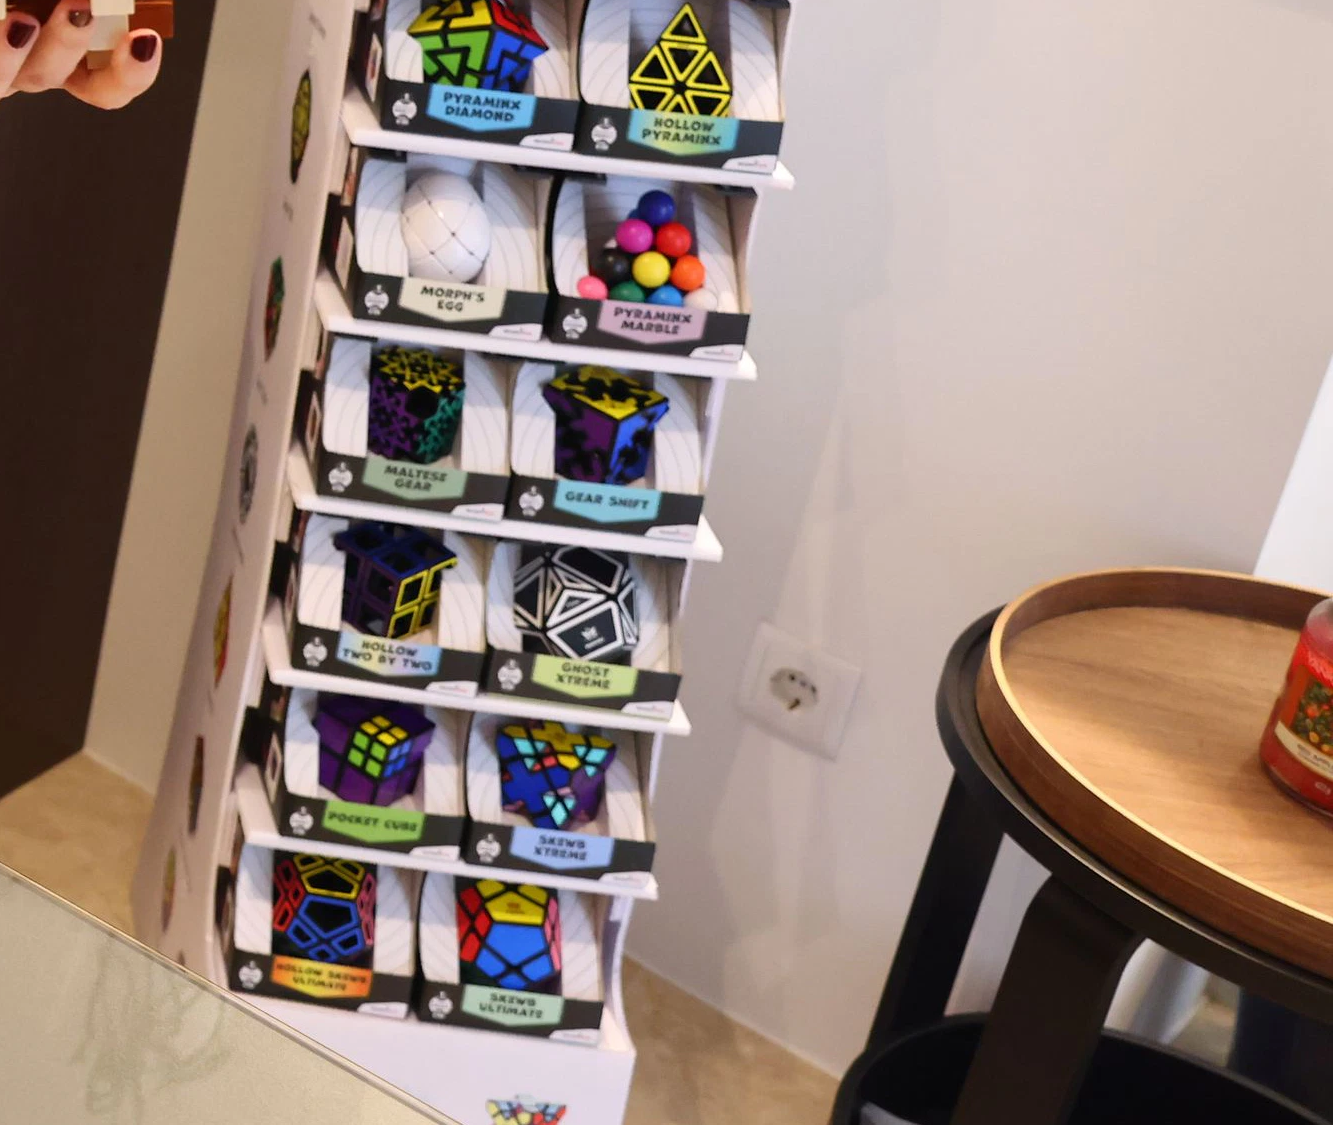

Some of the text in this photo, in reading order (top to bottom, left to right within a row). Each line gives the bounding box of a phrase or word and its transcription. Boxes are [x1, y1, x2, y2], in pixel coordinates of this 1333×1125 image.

[444, 92, 522, 111] PYRAMINX
[445, 106, 515, 123] DIAMOND
[654, 117, 714, 132] HOLLOW
[642, 129, 722, 146] PYRAMINX
[421, 285, 485, 303] MORPH'S
[437, 300, 464, 313] EGG
[614, 307, 692, 324] PYRAMINX
[621, 320, 680, 336] MARBLE
[385, 465, 447, 483] MALTESE
[394, 477, 432, 493] GEAR
[565, 490, 649, 510] GEAR SHIFT
[360, 641, 419, 657] HOLLOW
[342, 648, 432, 672] TWO BY TWO
[561, 661, 610, 678] GHOST
[555, 673, 611, 690] XTREME
[327, 810, 418, 833] POCKET CUBE
[539, 834, 586, 849] SKEWB
[533, 845, 587, 862] XTREME
[489, 992, 537, 1008] SKEWB
[479, 1002, 543, 1019] ULTIMATE
